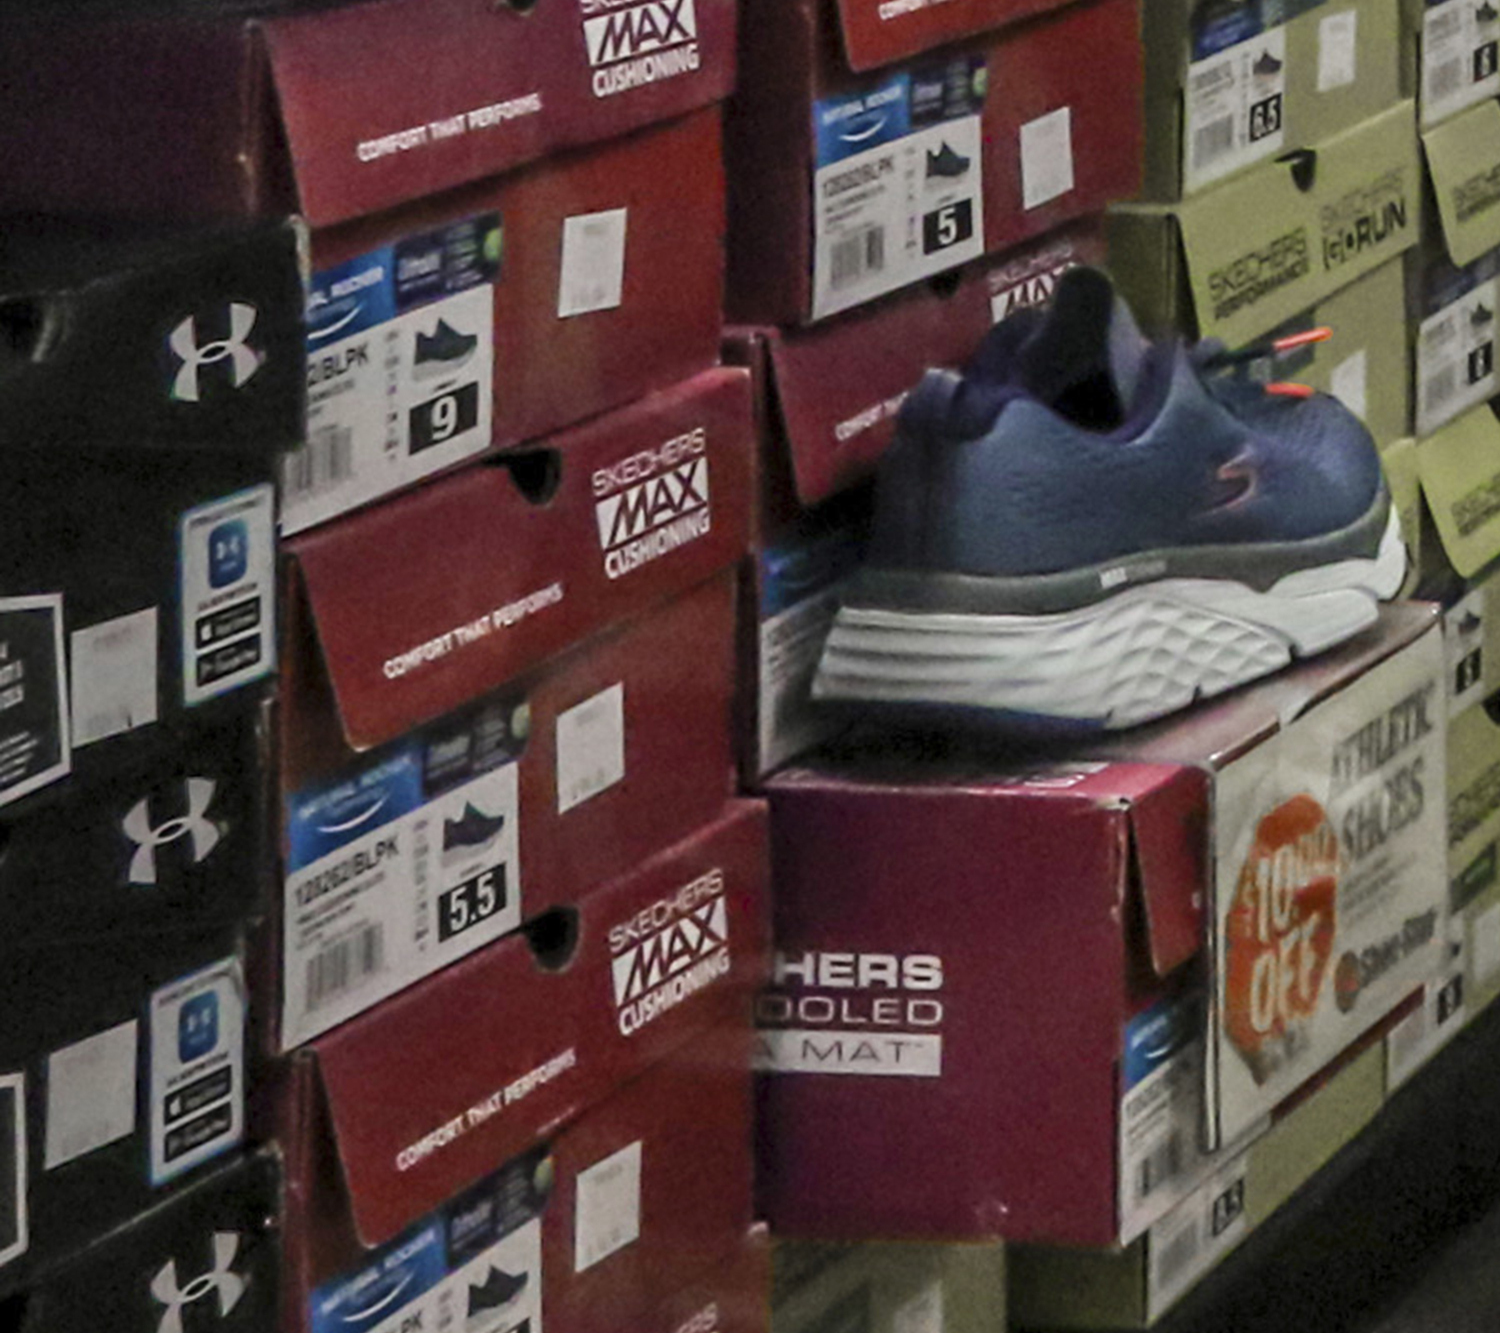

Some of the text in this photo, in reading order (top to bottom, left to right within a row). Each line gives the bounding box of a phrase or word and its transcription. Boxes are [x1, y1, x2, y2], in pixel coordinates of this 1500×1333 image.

[592, 43, 701, 98] CUSHIONING
[357, 92, 544, 162] COMFORT THAT PERFORMS
[938, 208, 958, 245] 5
[429, 397, 457, 440] 9
[592, 426, 706, 494] SKECHERS
[601, 455, 708, 552] MAX
[605, 511, 711, 580] CUSHIONING
[383, 582, 564, 680] COMFORT THAT PERFORMS
[446, 868, 502, 926] 5.5
[608, 868, 725, 954] SKECHERS
[620, 896, 728, 1003] MAX
[619, 951, 731, 1039] CUSHIONING
[396, 1119, 466, 1172] COMFORT
[465, 1099, 502, 1131] THAT
